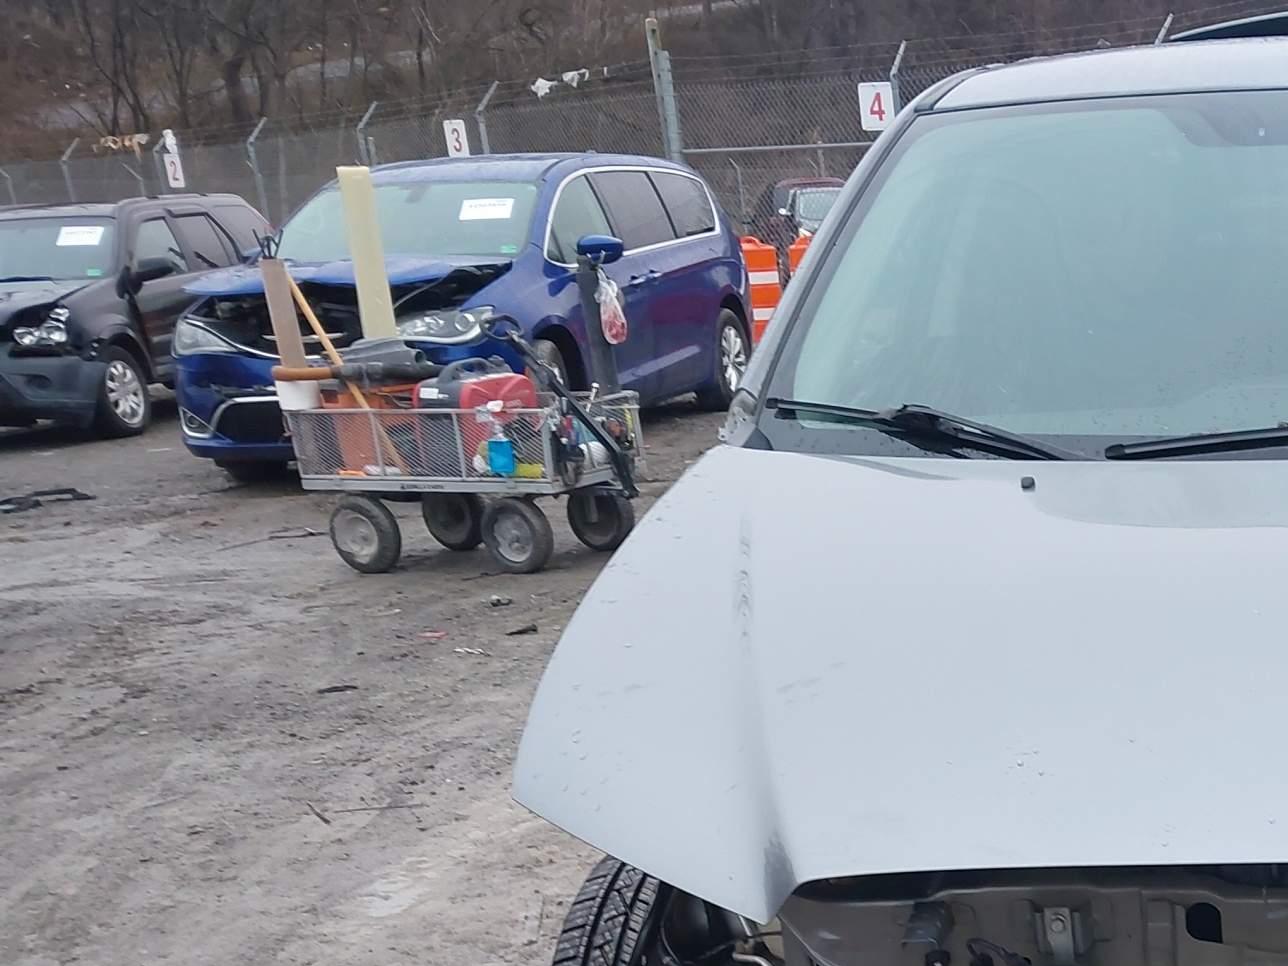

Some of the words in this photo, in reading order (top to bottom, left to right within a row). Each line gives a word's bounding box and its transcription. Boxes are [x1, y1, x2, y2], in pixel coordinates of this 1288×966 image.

[869, 91, 886, 122] 4
[450, 127, 463, 153] 3
[168, 159, 180, 182] 2
